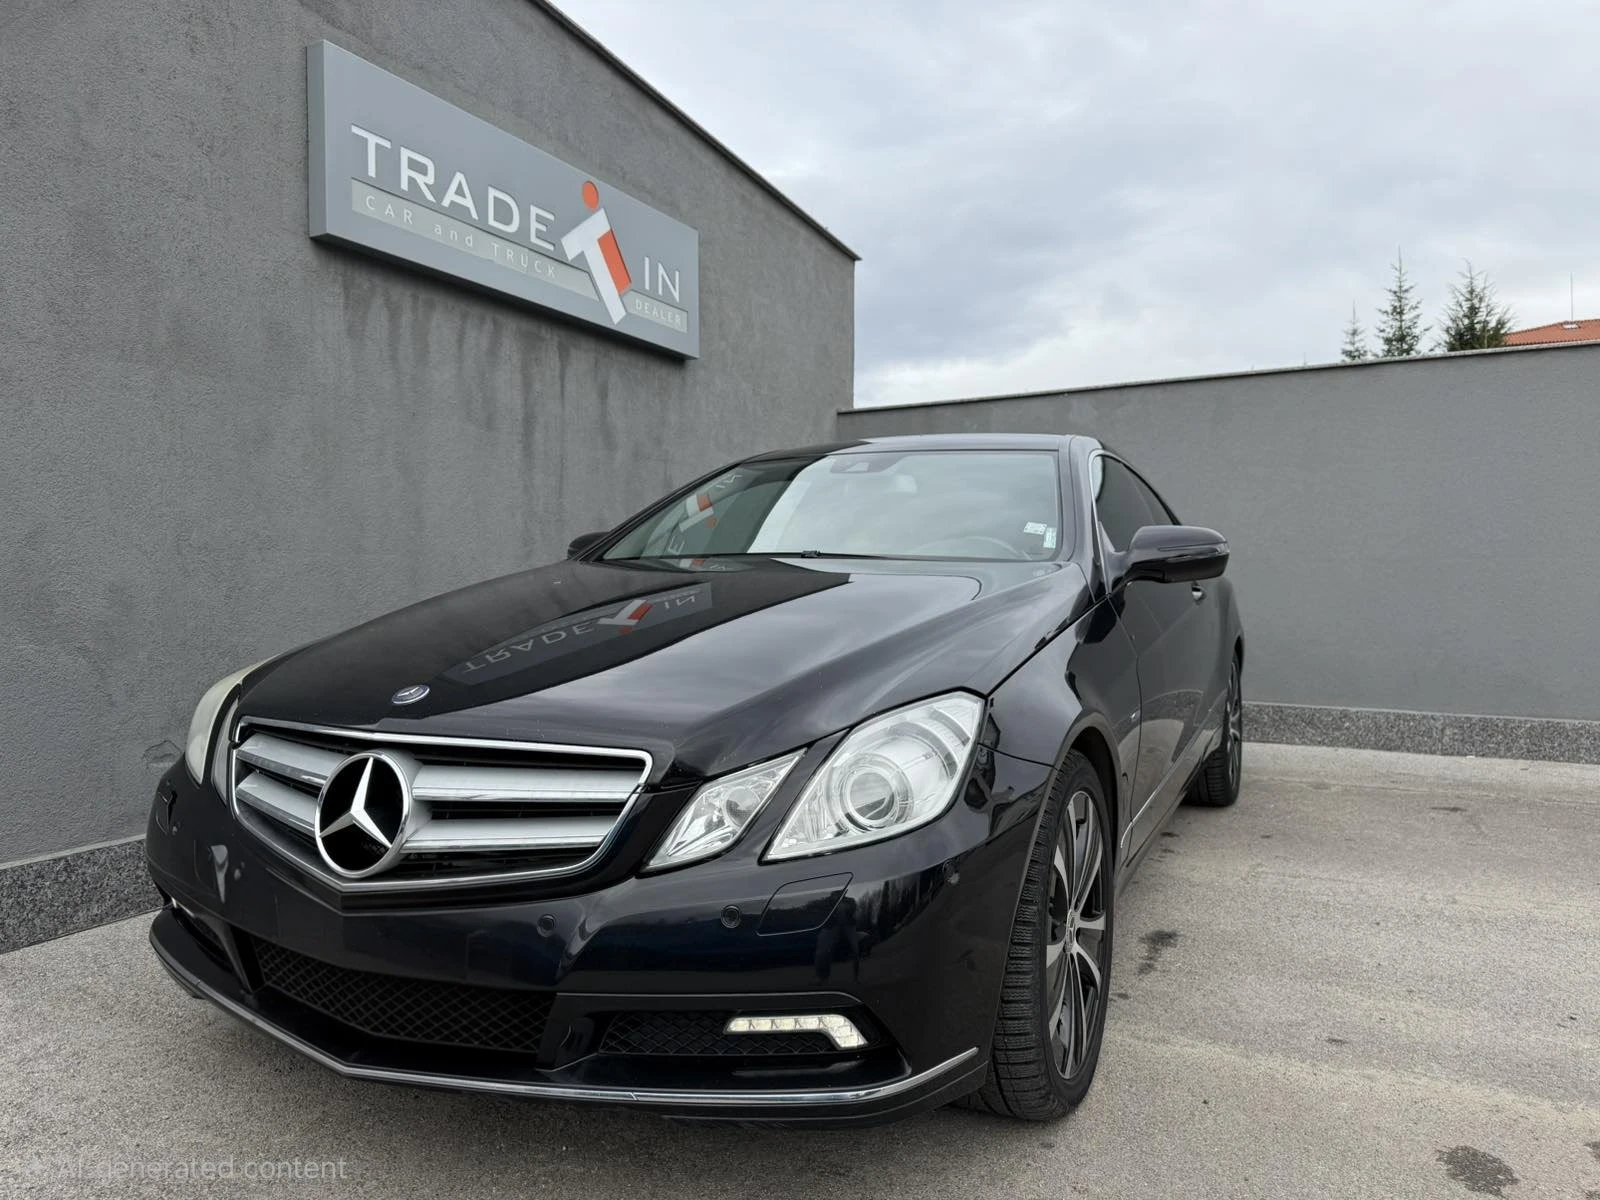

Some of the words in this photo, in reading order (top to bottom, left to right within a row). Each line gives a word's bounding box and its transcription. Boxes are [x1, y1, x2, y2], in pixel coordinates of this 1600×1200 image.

[351, 123, 556, 251] TRADE
[644, 256, 680, 303] IN
[365, 195, 413, 225] CAR
[434, 224, 473, 247] and
[491, 243, 557, 279] TRUCK
[635, 299, 682, 326] DEALER
